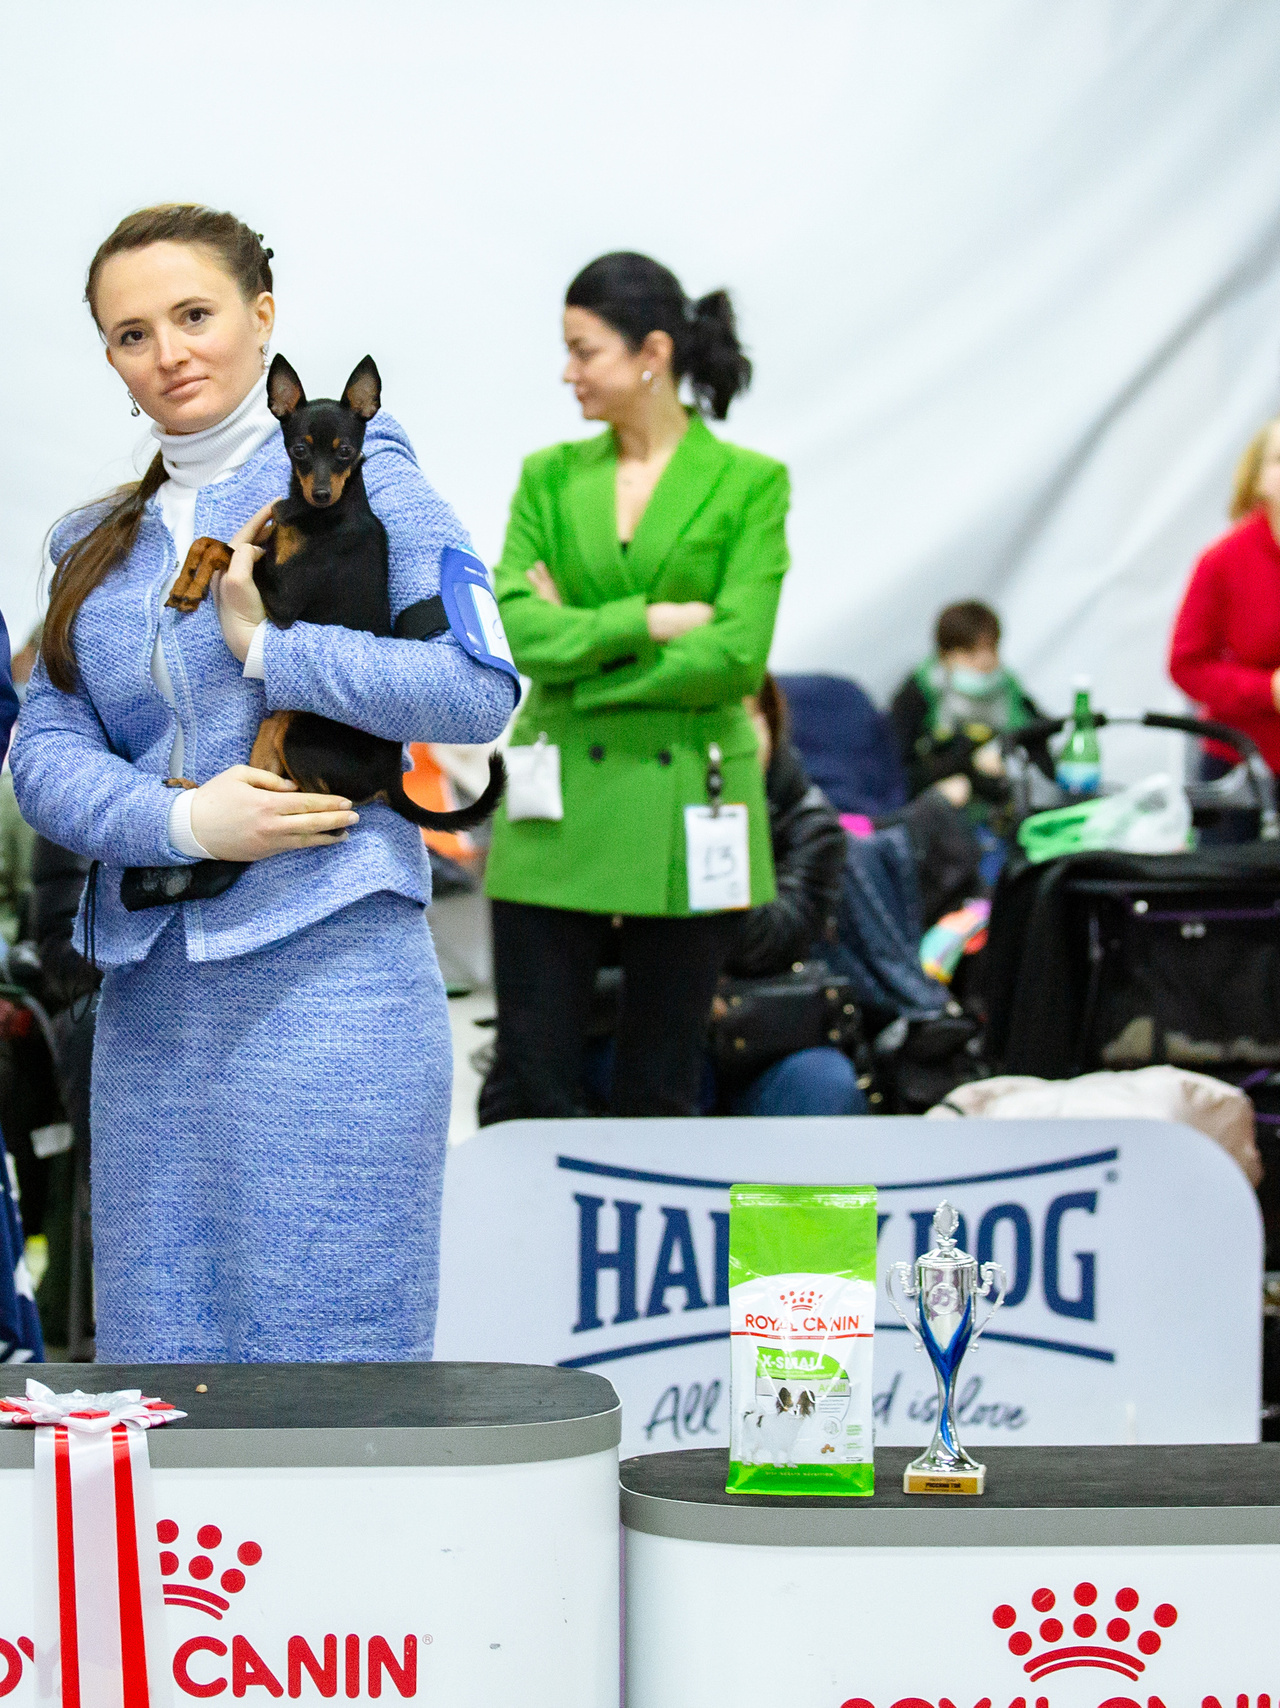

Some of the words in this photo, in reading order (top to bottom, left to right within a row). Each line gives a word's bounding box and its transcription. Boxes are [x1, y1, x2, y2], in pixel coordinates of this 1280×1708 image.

[803, 1315, 860, 1333] CANIN
[762, 1353, 825, 1371] X-SMALL
[644, 1377, 721, 1441] All
[172, 1634, 418, 1699] CANIN
